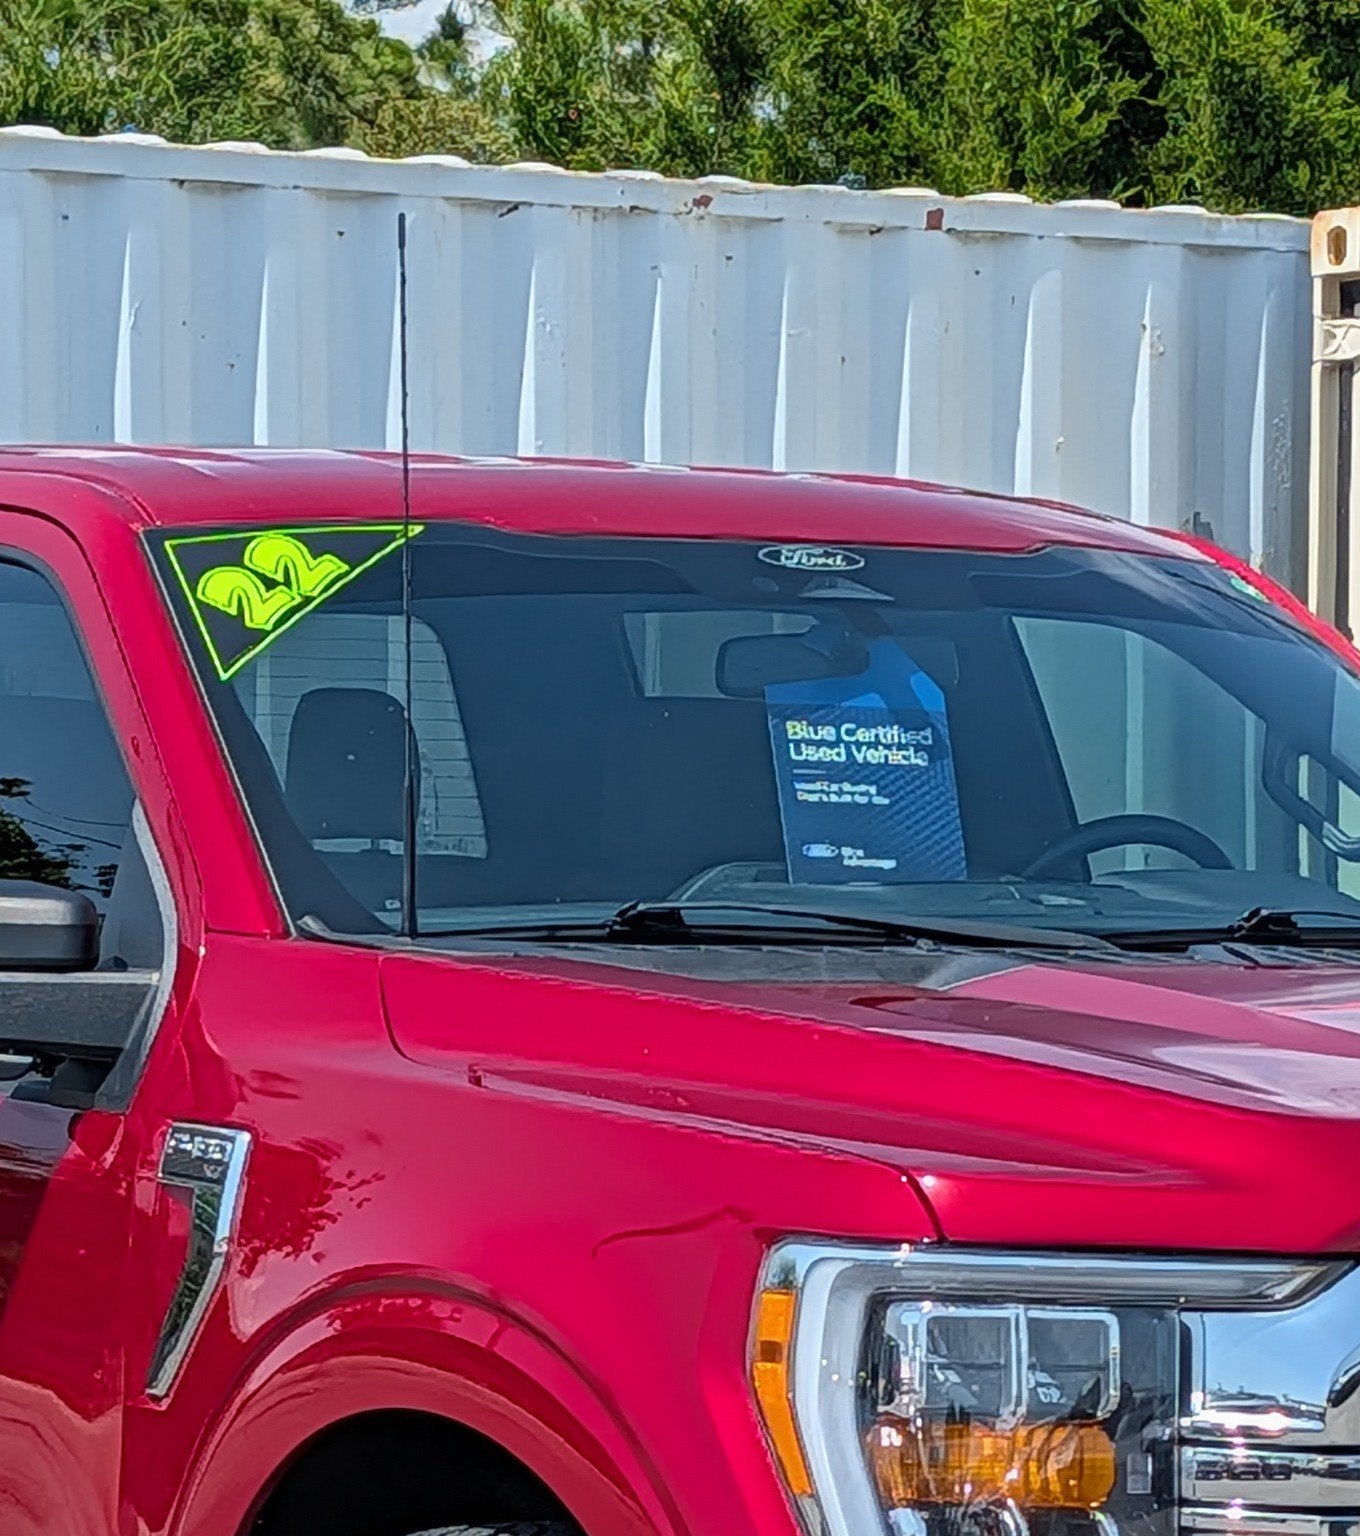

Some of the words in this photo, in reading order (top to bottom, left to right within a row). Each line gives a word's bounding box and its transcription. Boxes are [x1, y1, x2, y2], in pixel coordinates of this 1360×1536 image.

[197, 533, 350, 631] 22
[786, 721, 837, 741] Blue
[790, 743, 846, 763] Used
